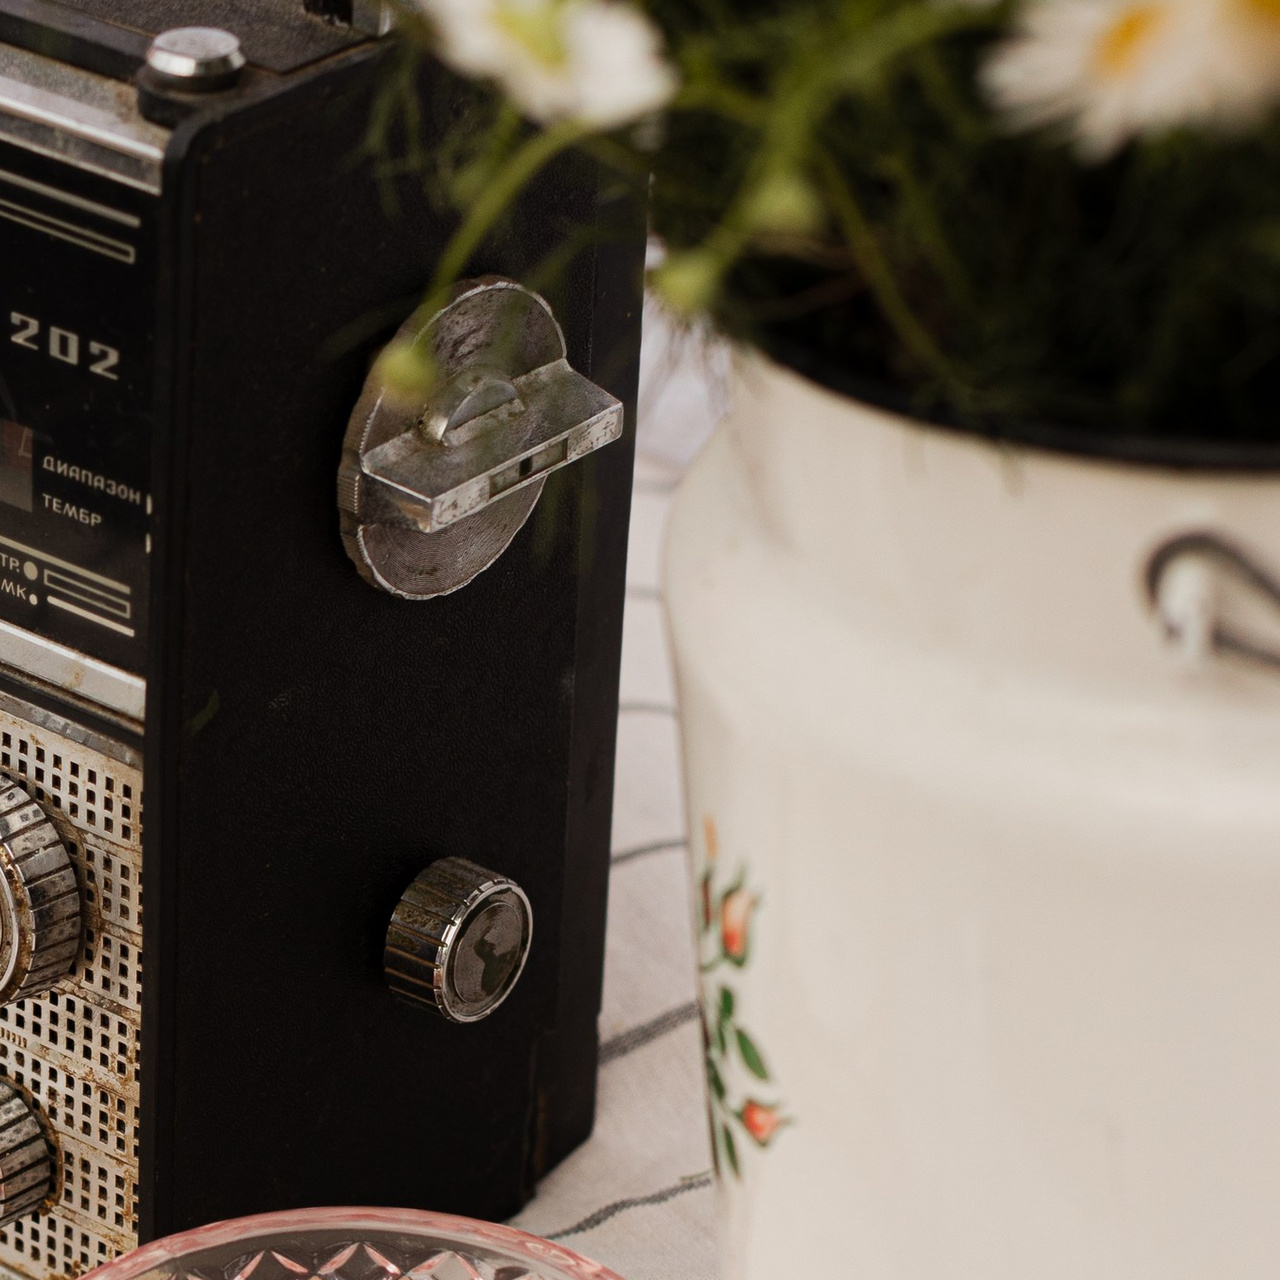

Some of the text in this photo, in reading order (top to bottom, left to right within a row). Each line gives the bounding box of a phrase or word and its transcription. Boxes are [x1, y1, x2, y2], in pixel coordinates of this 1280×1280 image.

[10, 311, 120, 381] 202
[42, 455, 141, 506] ДИАПАЗОН
[42, 493, 103, 527] ТЕМБР
